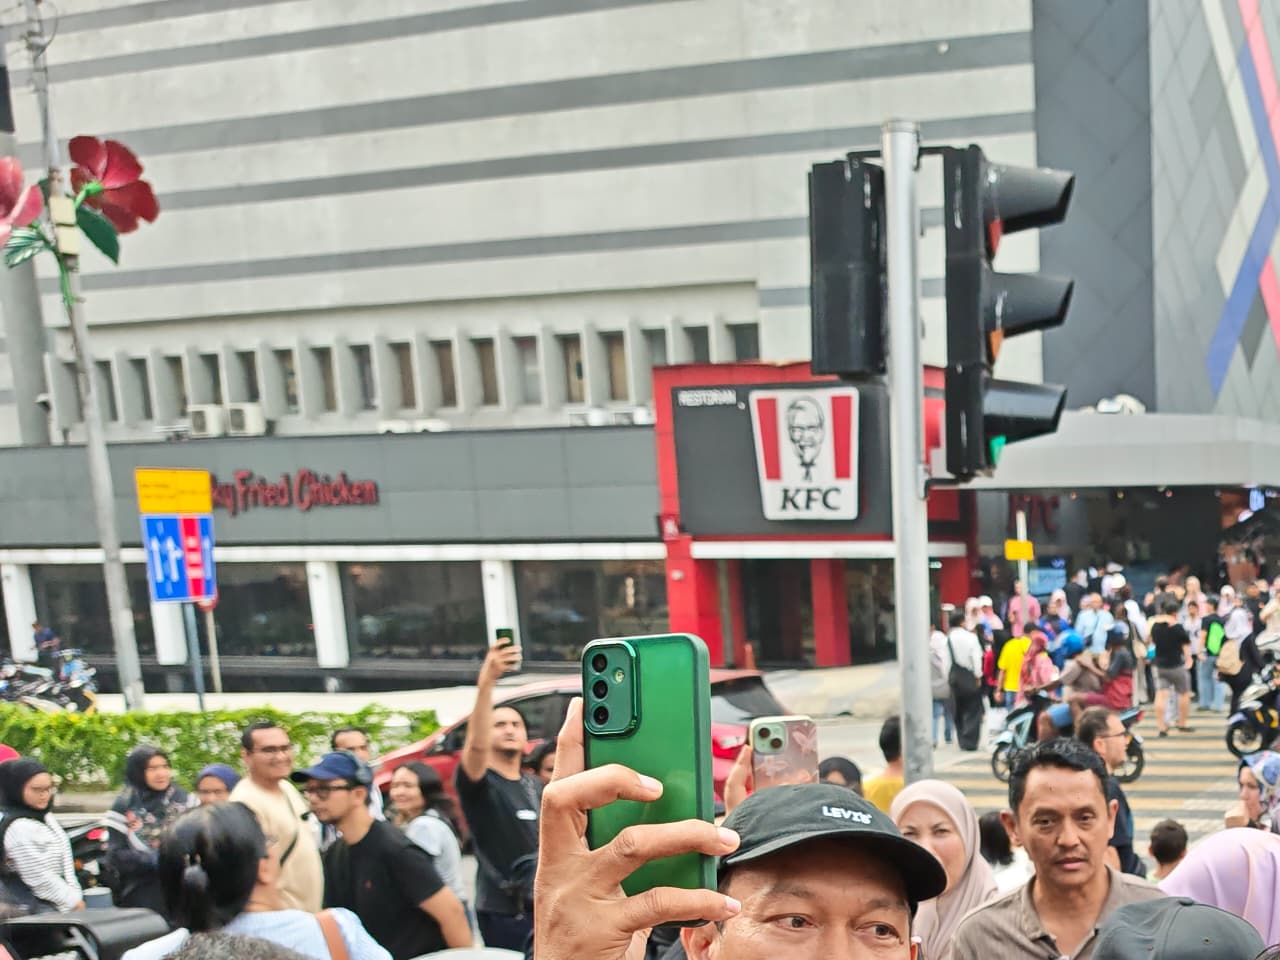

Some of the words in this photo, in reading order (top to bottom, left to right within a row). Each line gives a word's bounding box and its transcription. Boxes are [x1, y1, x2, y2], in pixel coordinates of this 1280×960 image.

[234, 468, 290, 512] Fried
[294, 468, 378, 511] Chicken
[780, 488, 841, 511] KFC
